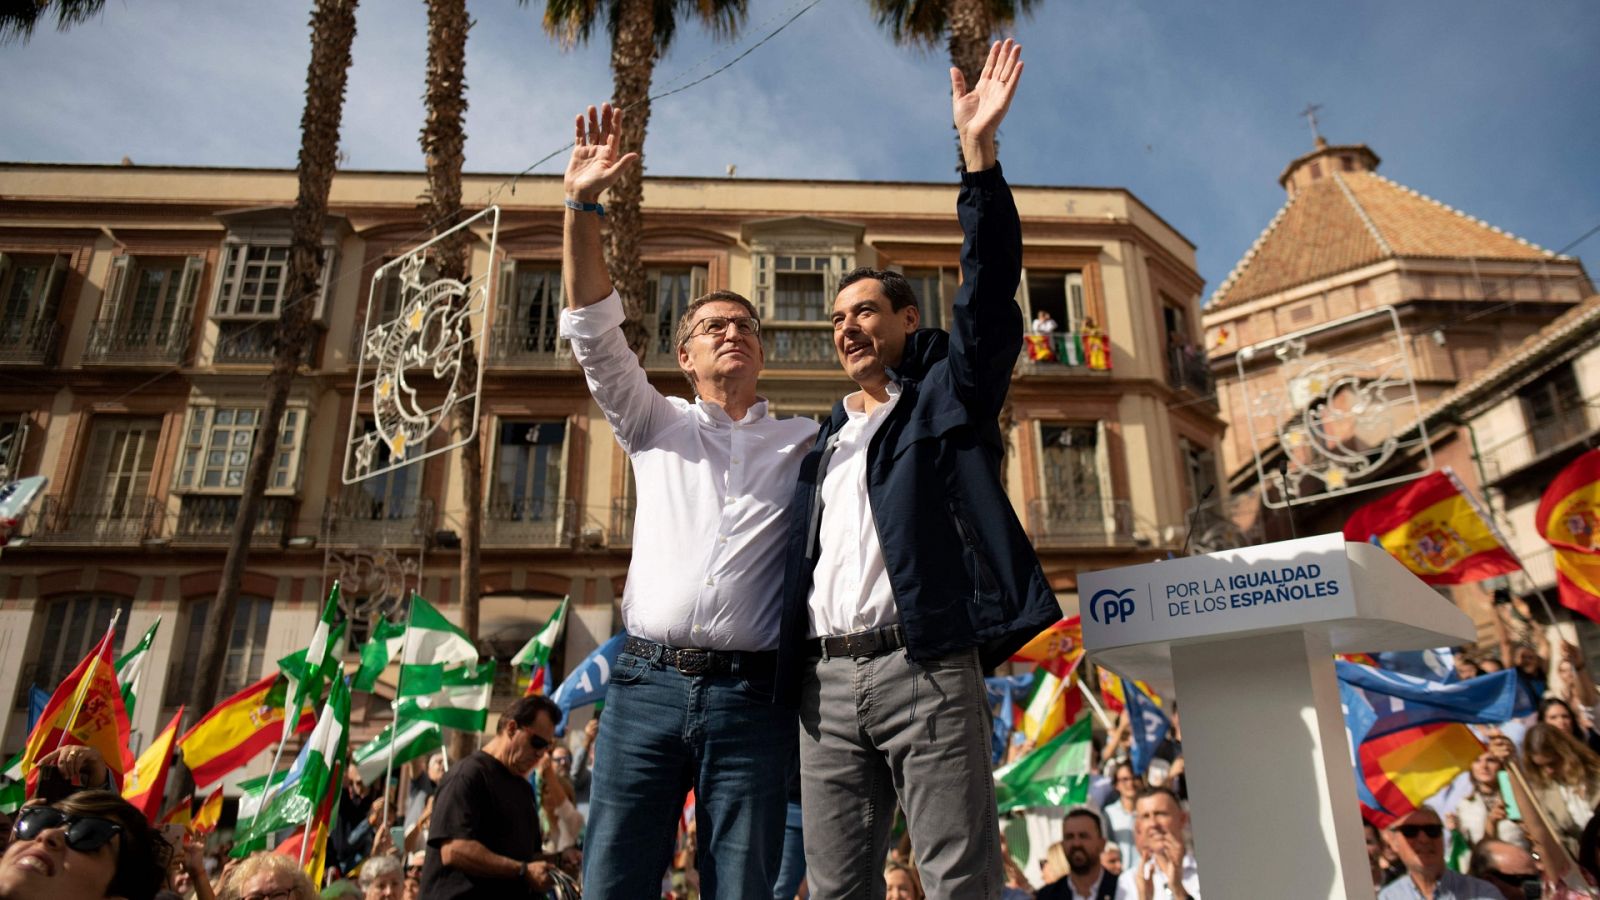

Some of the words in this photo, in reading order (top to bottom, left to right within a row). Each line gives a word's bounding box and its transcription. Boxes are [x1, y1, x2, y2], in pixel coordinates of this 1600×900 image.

[1166, 581, 1200, 599] POR
[1203, 578, 1226, 594] LA
[1229, 564, 1321, 590] IGUALDAD
[1168, 600, 1191, 617] DE
[1194, 596, 1227, 613] LOS
[1230, 580, 1339, 609] ESPAÑOLES
